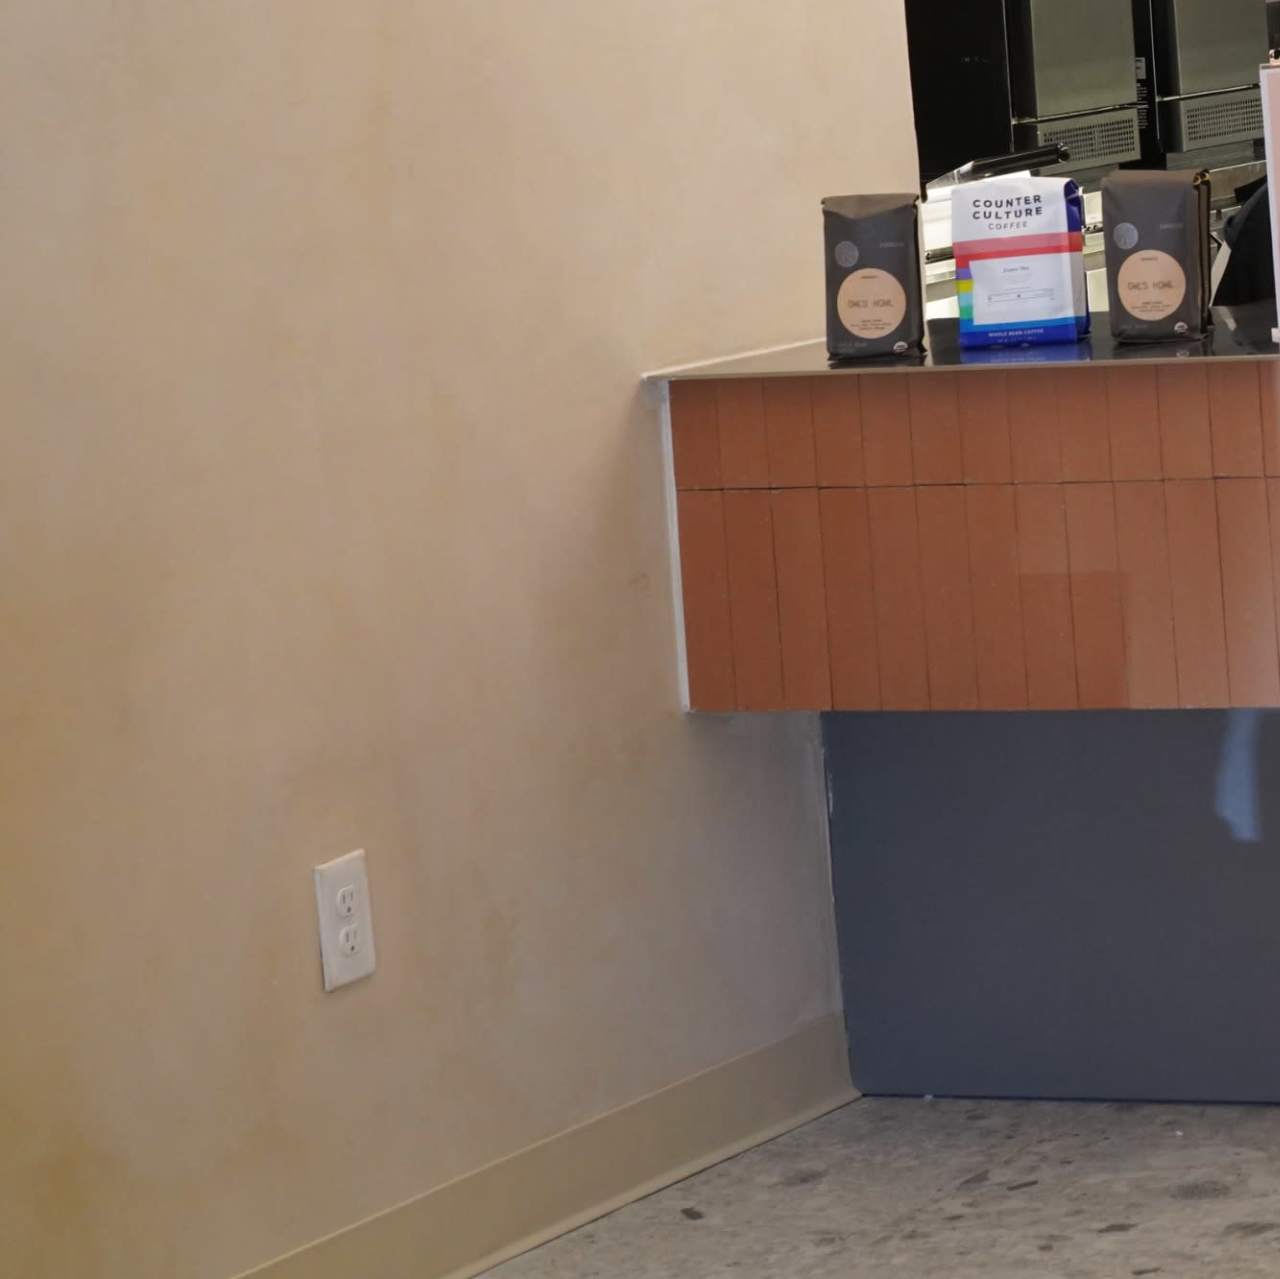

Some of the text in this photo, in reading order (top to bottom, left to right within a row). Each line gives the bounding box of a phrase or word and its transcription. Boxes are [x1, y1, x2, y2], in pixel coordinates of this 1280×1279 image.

[972, 194, 1043, 208] COUNTER
[972, 206, 1044, 220] CULTURE
[988, 220, 1028, 231] COFFEE
